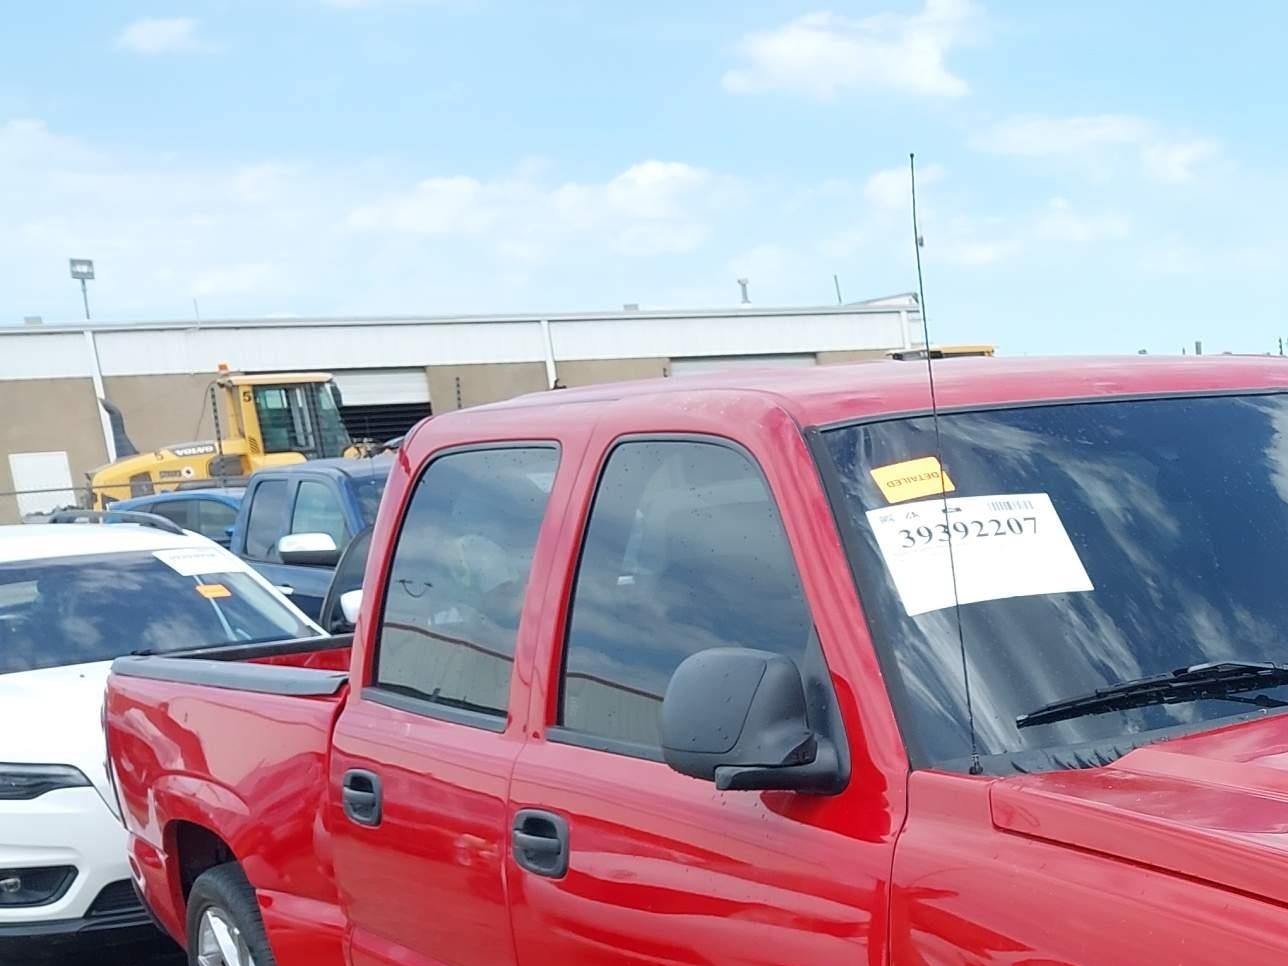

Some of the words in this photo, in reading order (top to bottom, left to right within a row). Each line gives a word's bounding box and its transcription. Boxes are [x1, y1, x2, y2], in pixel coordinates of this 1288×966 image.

[242, 391, 252, 403] 5
[174, 445, 214, 456] VOLVO
[886, 471, 940, 488] DETAILED
[898, 516, 1037, 549] 39392207
